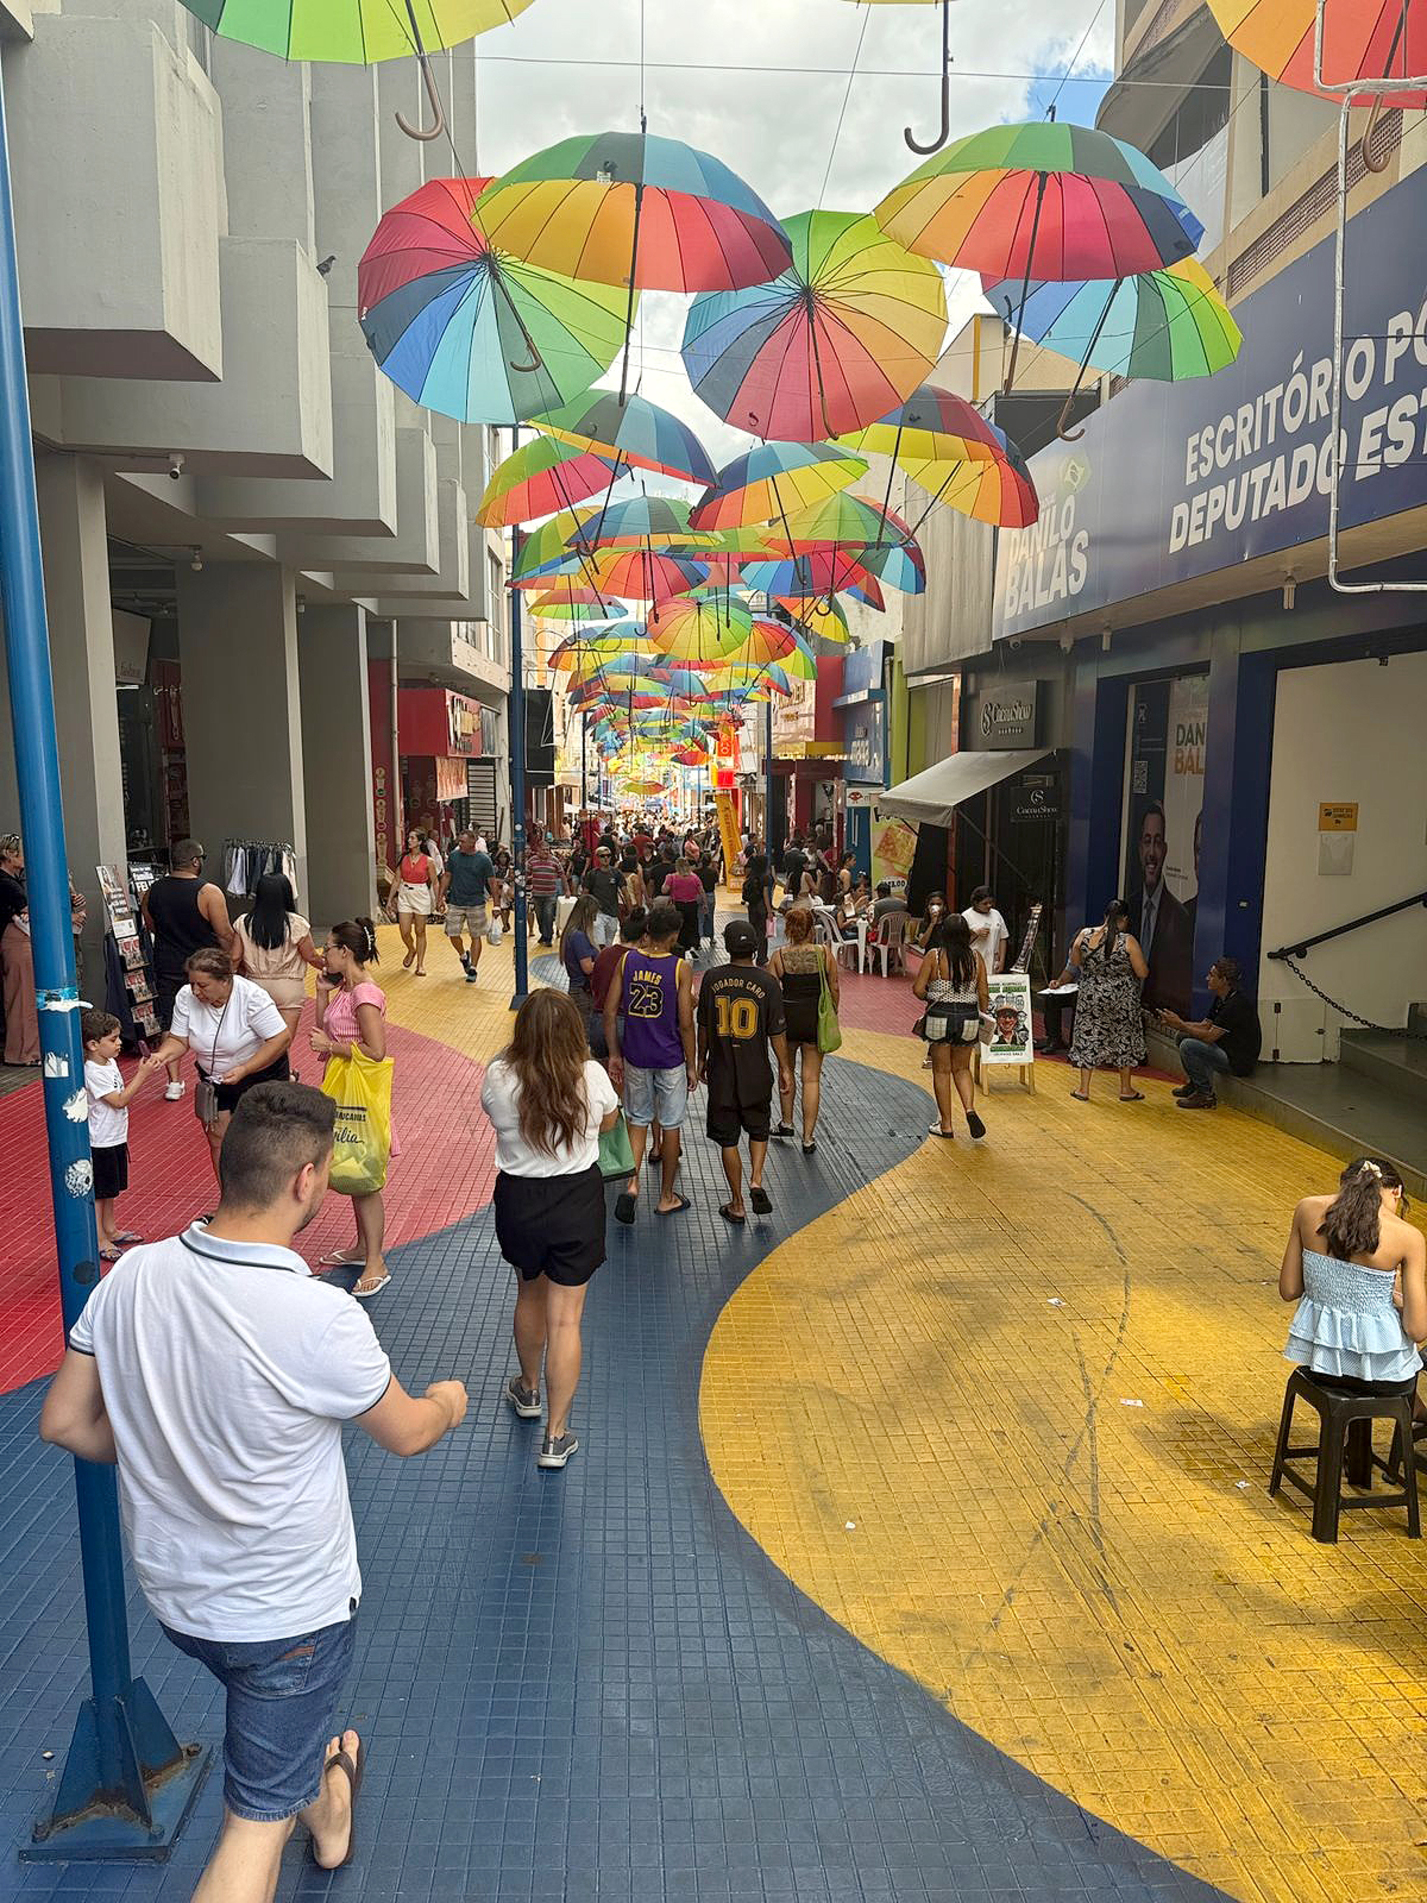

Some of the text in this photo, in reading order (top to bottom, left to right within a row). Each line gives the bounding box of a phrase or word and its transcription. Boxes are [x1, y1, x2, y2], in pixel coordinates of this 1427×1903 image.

[1186, 335, 1375, 486] ESCRITÓRO
[1169, 428, 1348, 554] DEPUTADO
[1004, 529, 1089, 620] BALAS
[628, 982, 665, 1019] 23
[632, 970, 663, 986] JAMES
[711, 977, 767, 1000] JOGADOR CARO
[714, 994, 759, 1040] 10
